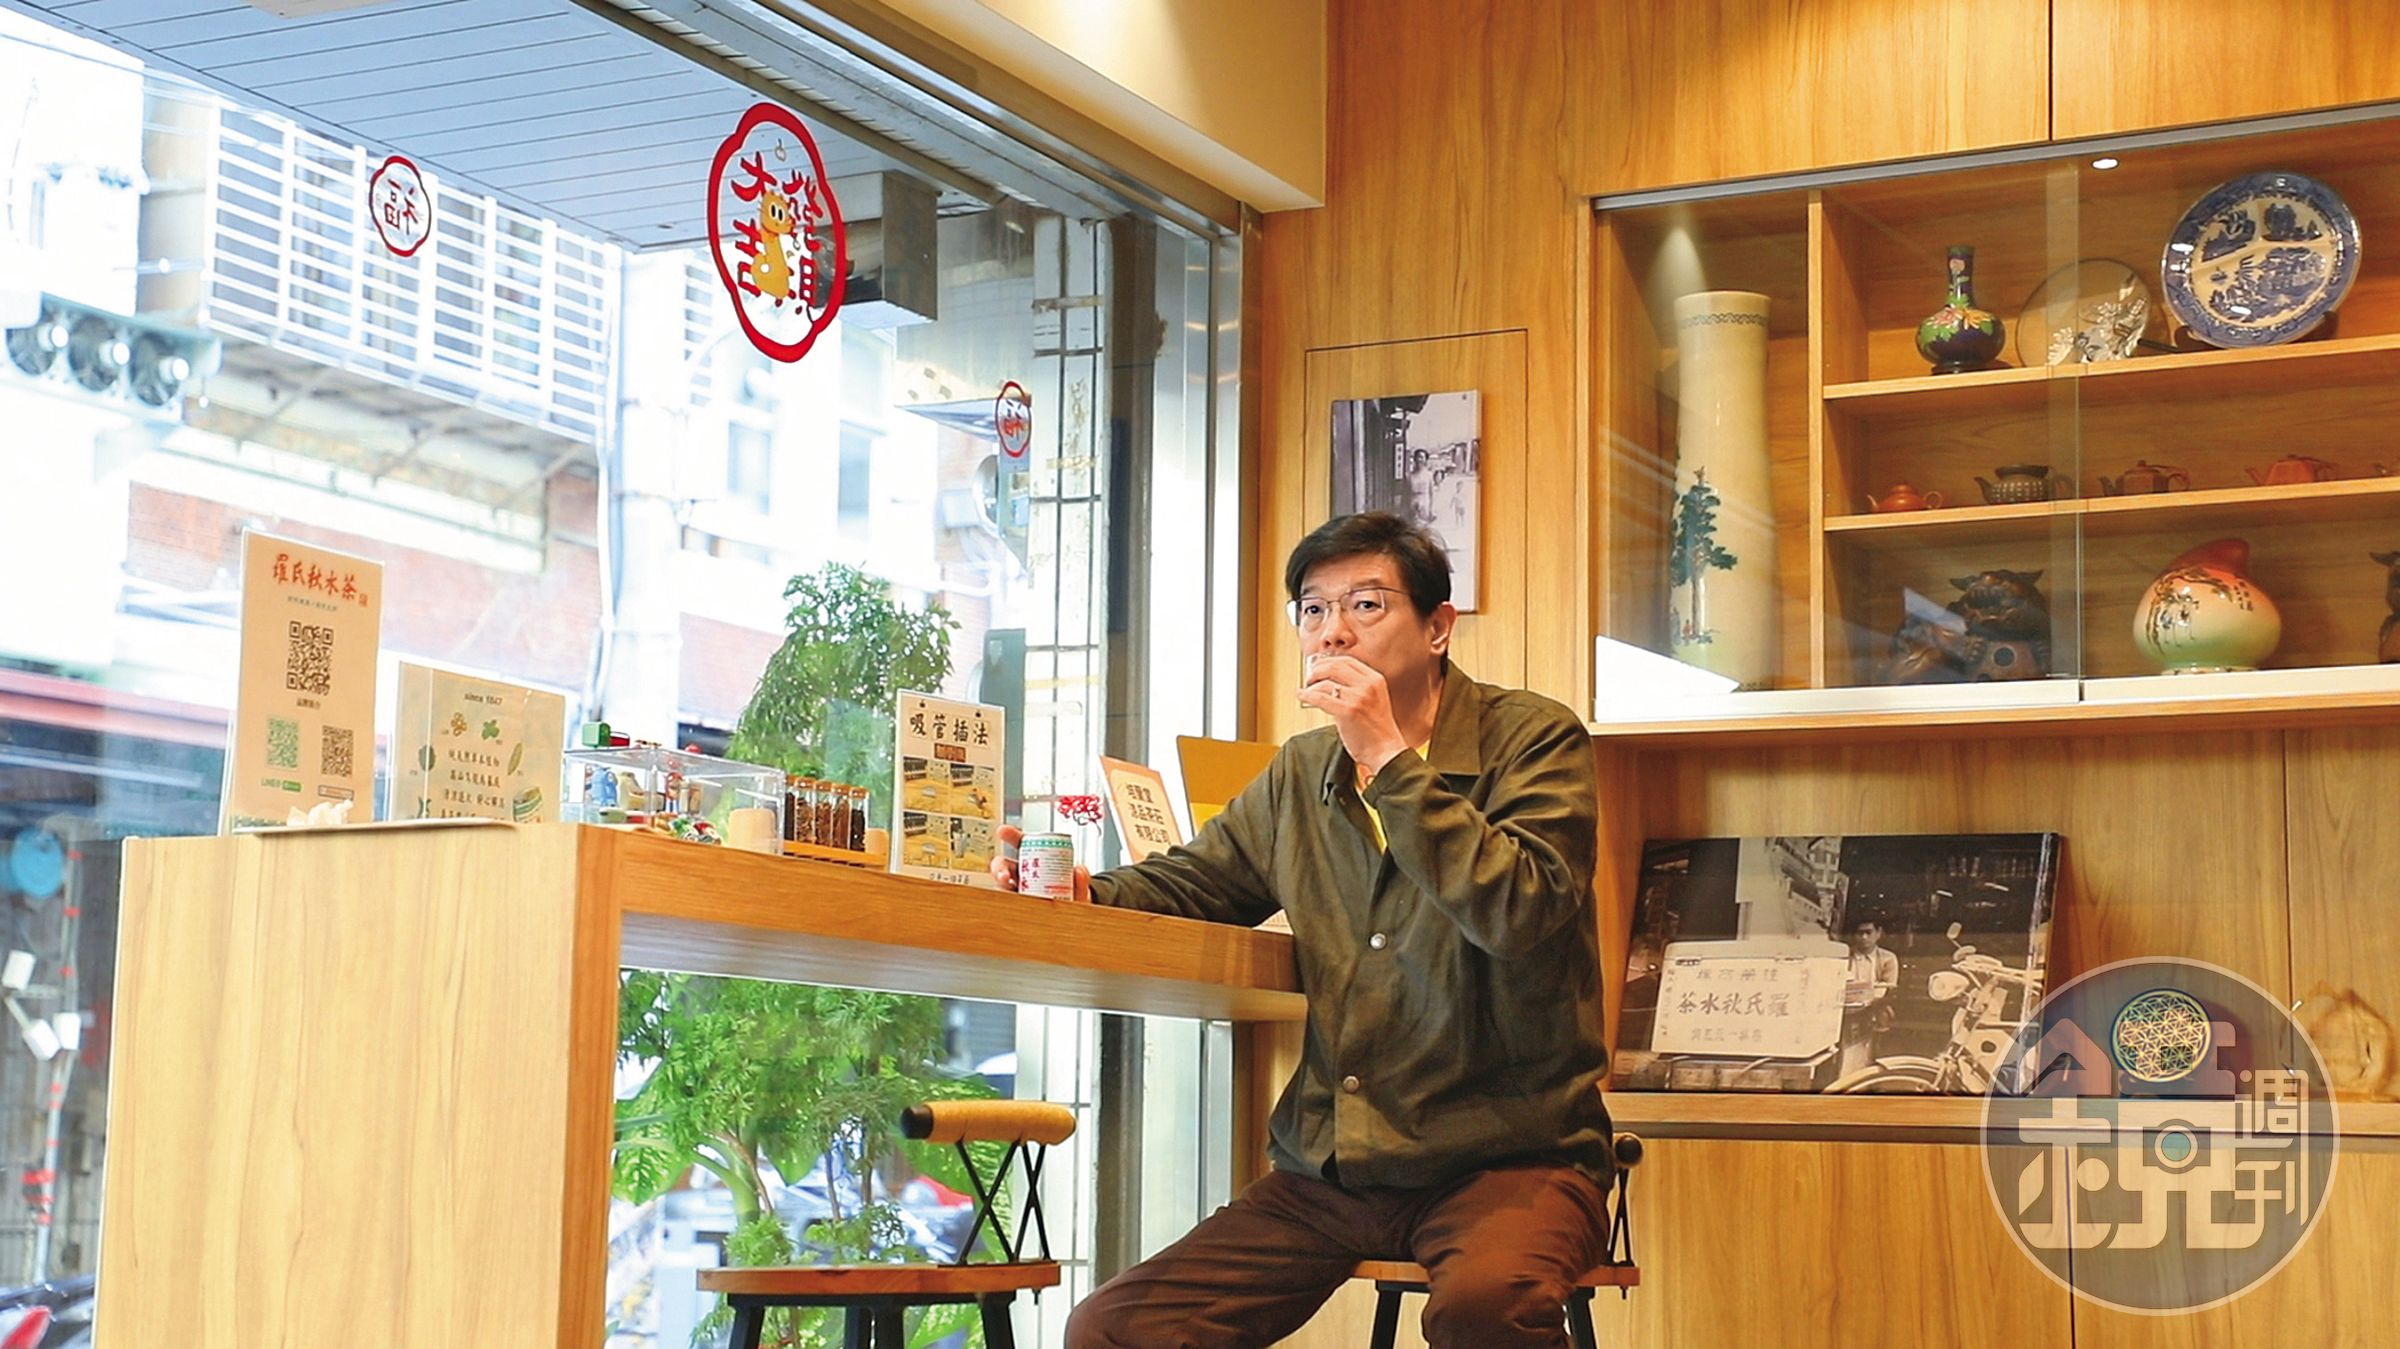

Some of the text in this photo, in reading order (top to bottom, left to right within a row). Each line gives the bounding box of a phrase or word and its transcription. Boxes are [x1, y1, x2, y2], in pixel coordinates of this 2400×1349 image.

[272, 553, 358, 600] 羅氏秋水茶
[909, 712, 989, 746] 吸管插法
